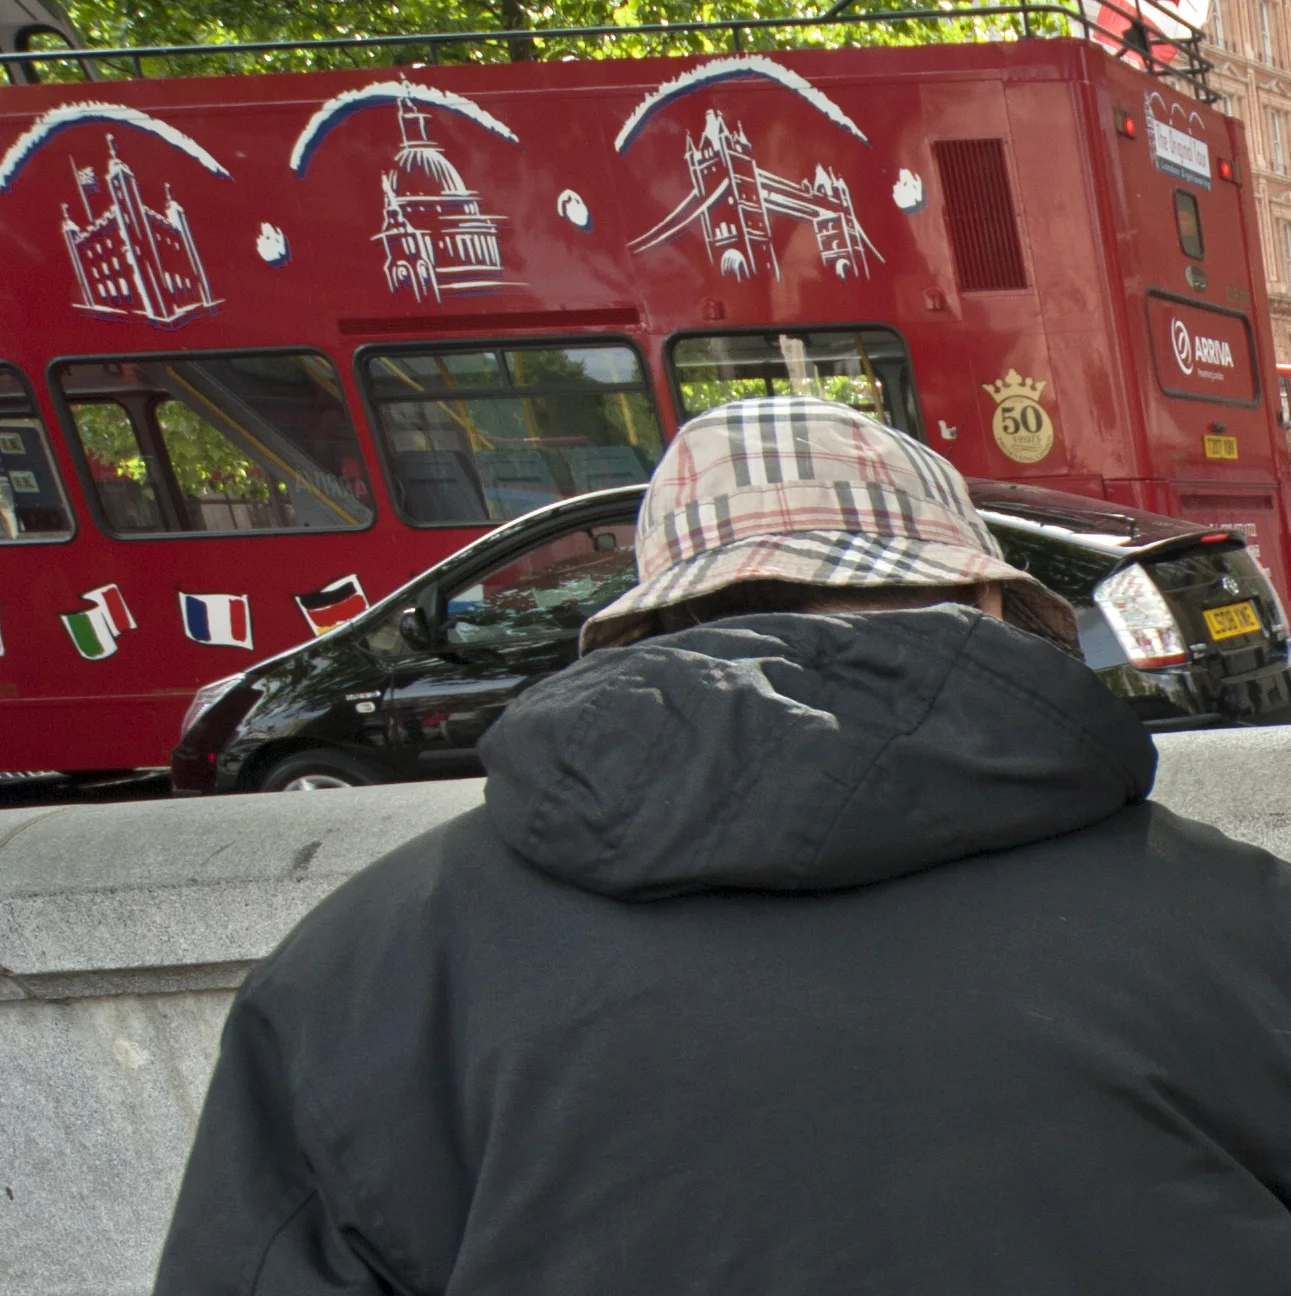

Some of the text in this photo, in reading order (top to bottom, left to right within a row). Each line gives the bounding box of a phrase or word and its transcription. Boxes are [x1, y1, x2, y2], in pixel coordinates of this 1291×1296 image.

[1195, 335, 1234, 368] ARRIVA
[1001, 404, 1043, 435] 50
[1012, 435, 1041, 446] years
